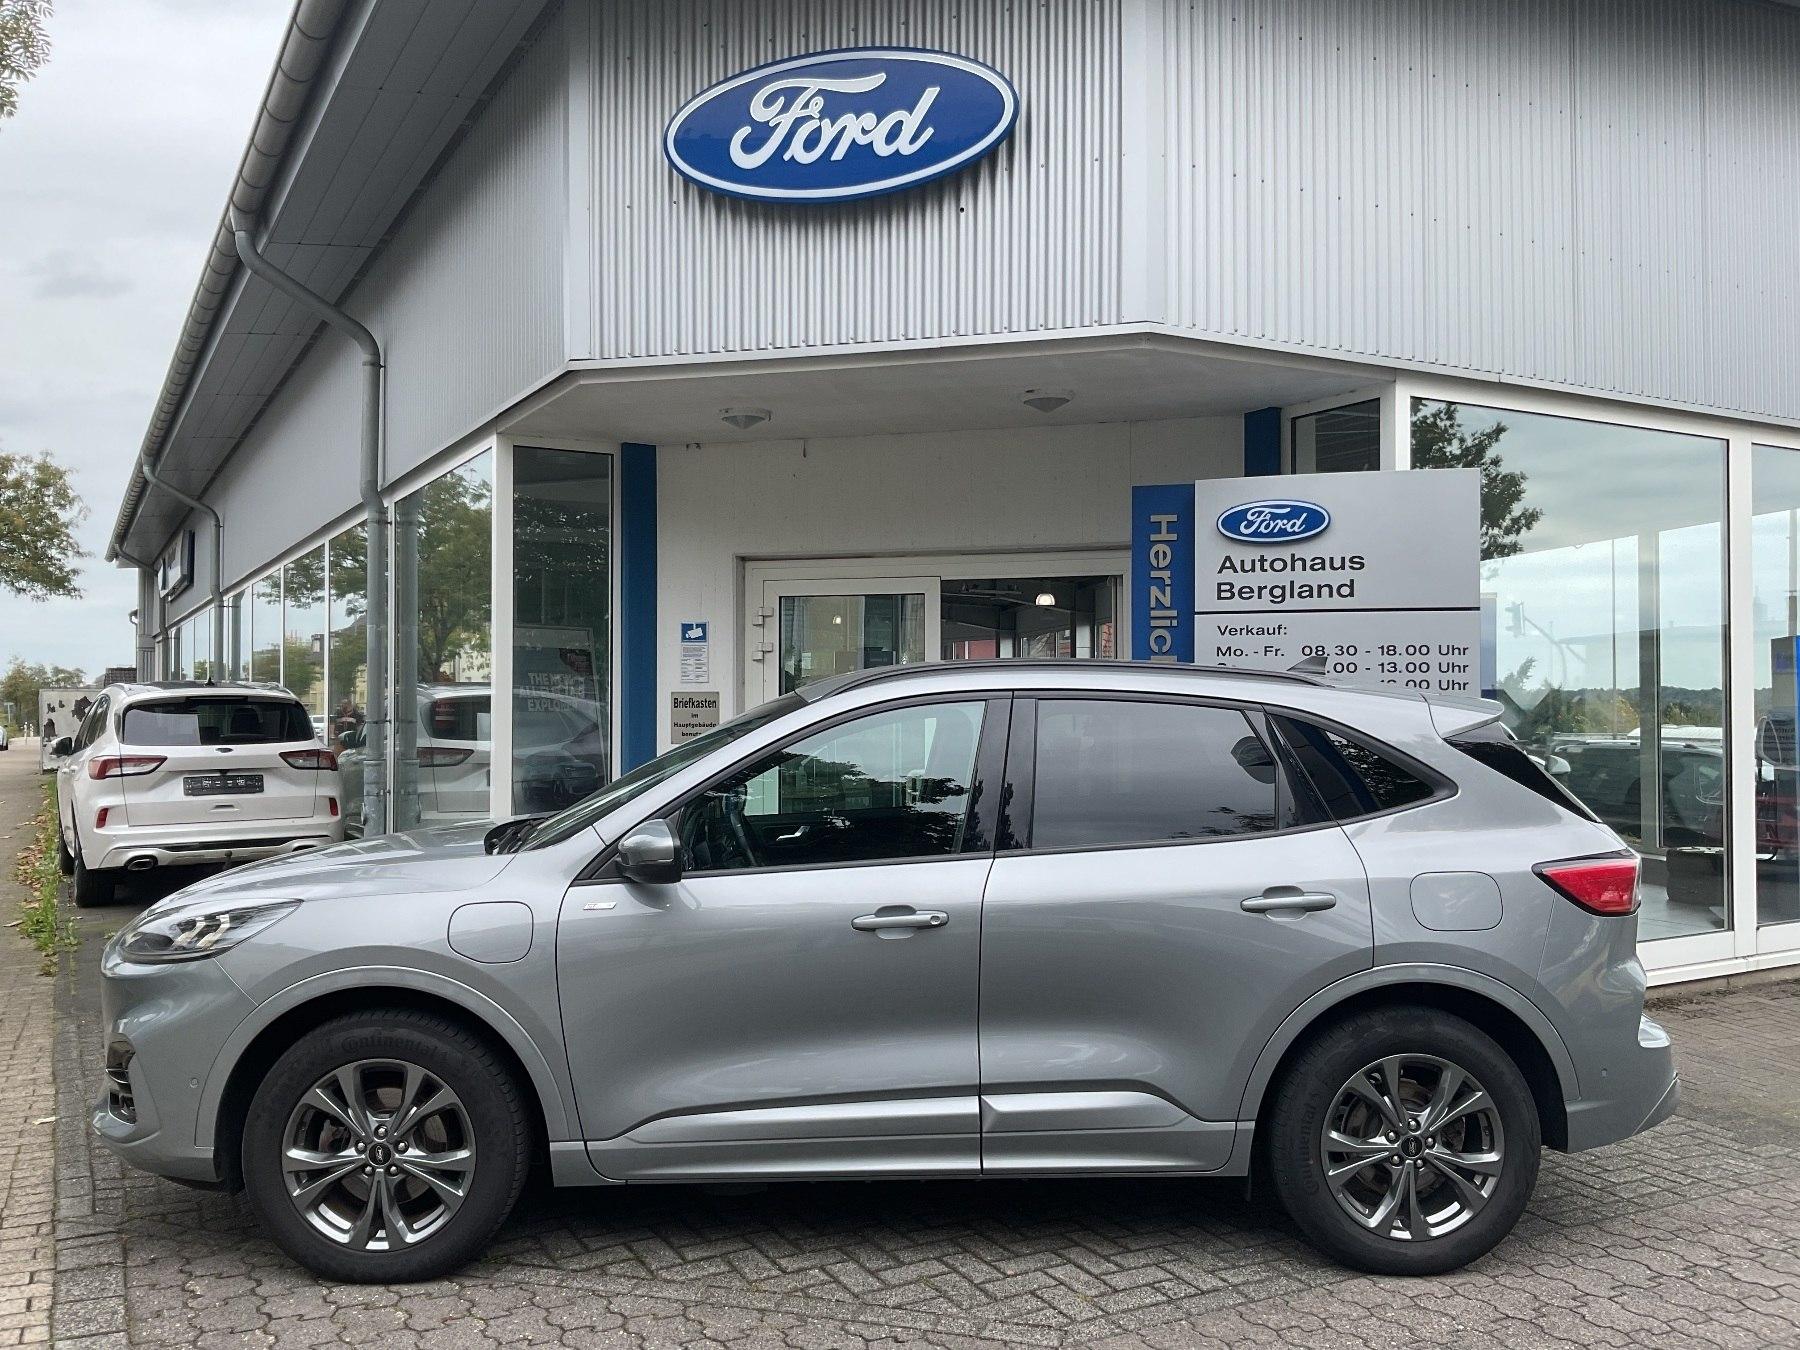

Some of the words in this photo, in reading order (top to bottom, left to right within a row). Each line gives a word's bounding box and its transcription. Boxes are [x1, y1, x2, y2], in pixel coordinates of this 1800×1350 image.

[729, 72, 941, 170] Ford
[1239, 507, 1308, 535] Ford
[1217, 553, 1366, 574] Autohaus
[1216, 578, 1355, 604] Bergland
[1216, 624, 1288, 636] Verkauf:
[1216, 646, 1249, 657] Mo.
[1263, 645, 1285, 657] Fr.
[1301, 645, 1358, 657] 08.30
[1378, 644, 1430, 656] 18.00
[1438, 644, 1469, 656] Uhr
[1326, 662, 1358, 674] .00
[1378, 662, 1430, 674] 13.00
[1438, 662, 1469, 674] Uhr
[1438, 680, 1469, 691] Uhr
[527, 699, 573, 712] EXPLO
[673, 697, 717, 709] Briefkasten
